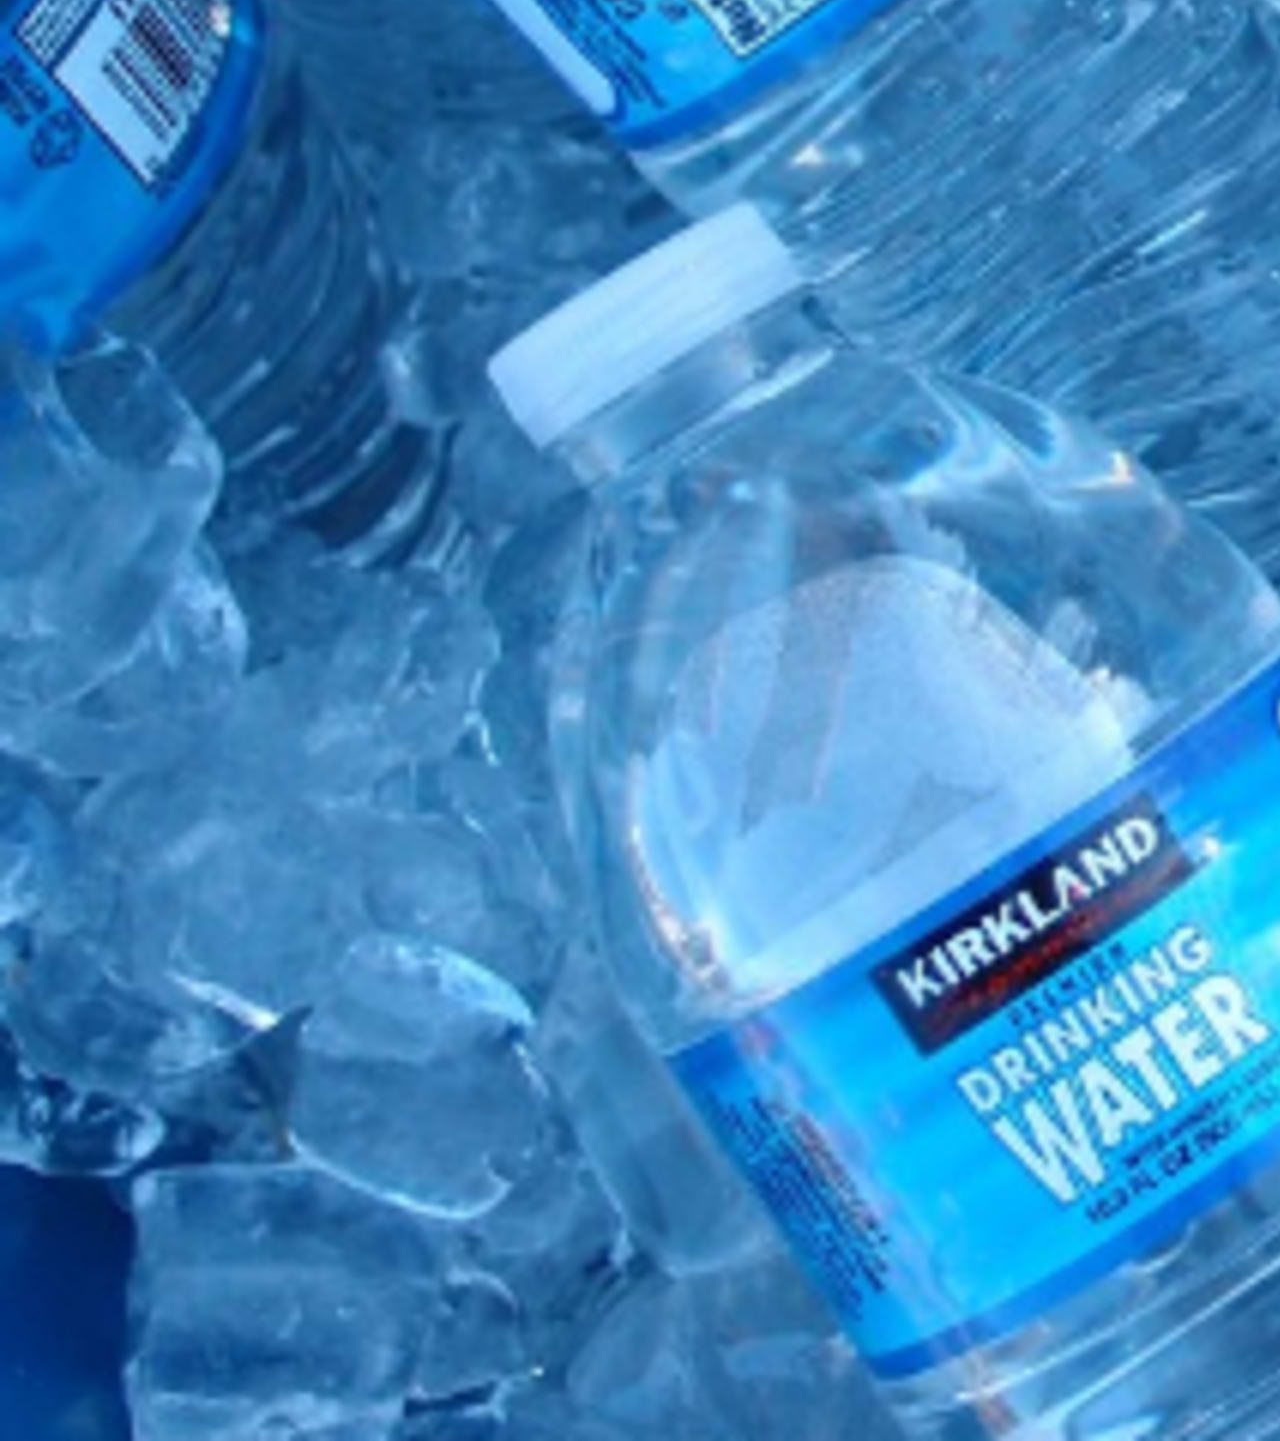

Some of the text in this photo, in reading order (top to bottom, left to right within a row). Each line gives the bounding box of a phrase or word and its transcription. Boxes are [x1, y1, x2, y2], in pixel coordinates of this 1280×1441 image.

[893, 809, 1166, 1011] KIRKLAND
[956, 920, 1217, 1116] DRINKING
[992, 967, 1274, 1207] WATER
